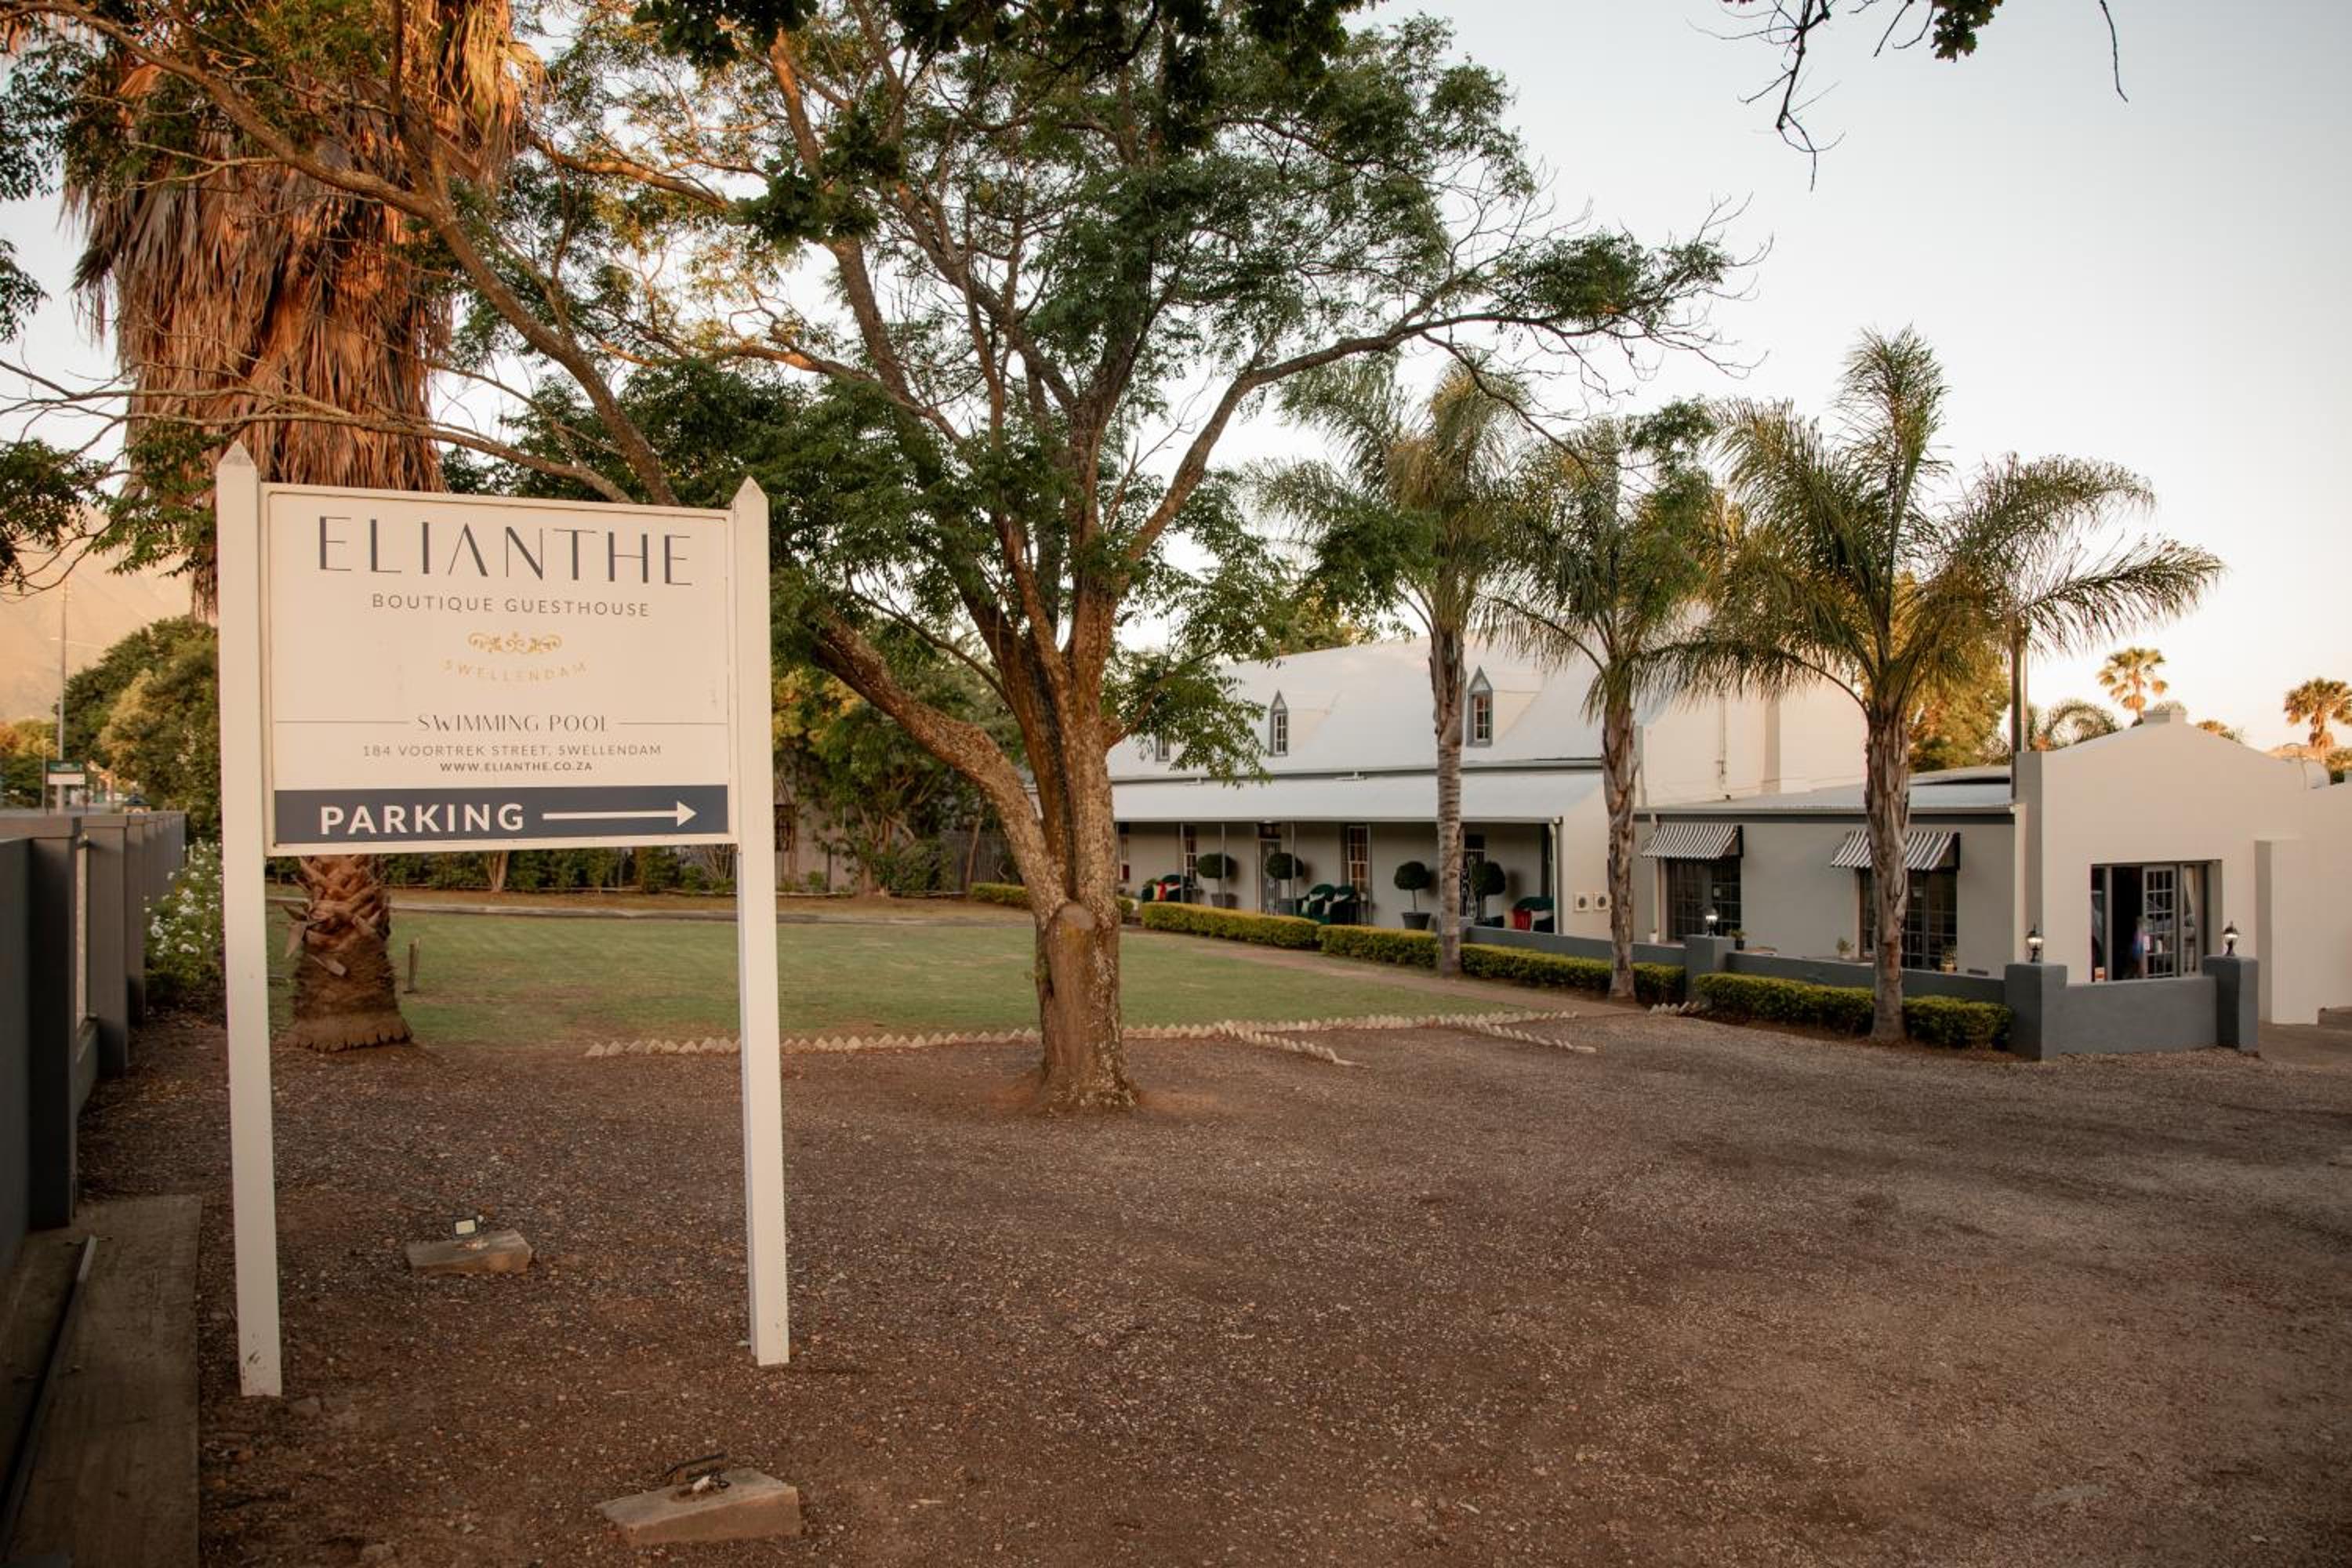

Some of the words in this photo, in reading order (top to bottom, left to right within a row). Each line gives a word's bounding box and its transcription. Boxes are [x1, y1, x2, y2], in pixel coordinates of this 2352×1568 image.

[318, 515, 693, 586] ELIANTHE
[372, 593, 492, 613] BOUTIQUE
[504, 598, 649, 618] GUESTHOUSE
[442, 660, 587, 682] SWELLENDAM
[417, 714, 539, 732] SWIMMING
[550, 714, 608, 732] POOL
[364, 746, 390, 757] 184
[398, 746, 485, 757] VOORTREK
[492, 746, 552, 757] STREET,
[558, 745, 661, 757] SWELLENDAM
[440, 761, 593, 772] WWW.ELIANTHE.CO.ZA
[320, 803, 524, 836] PARKING
